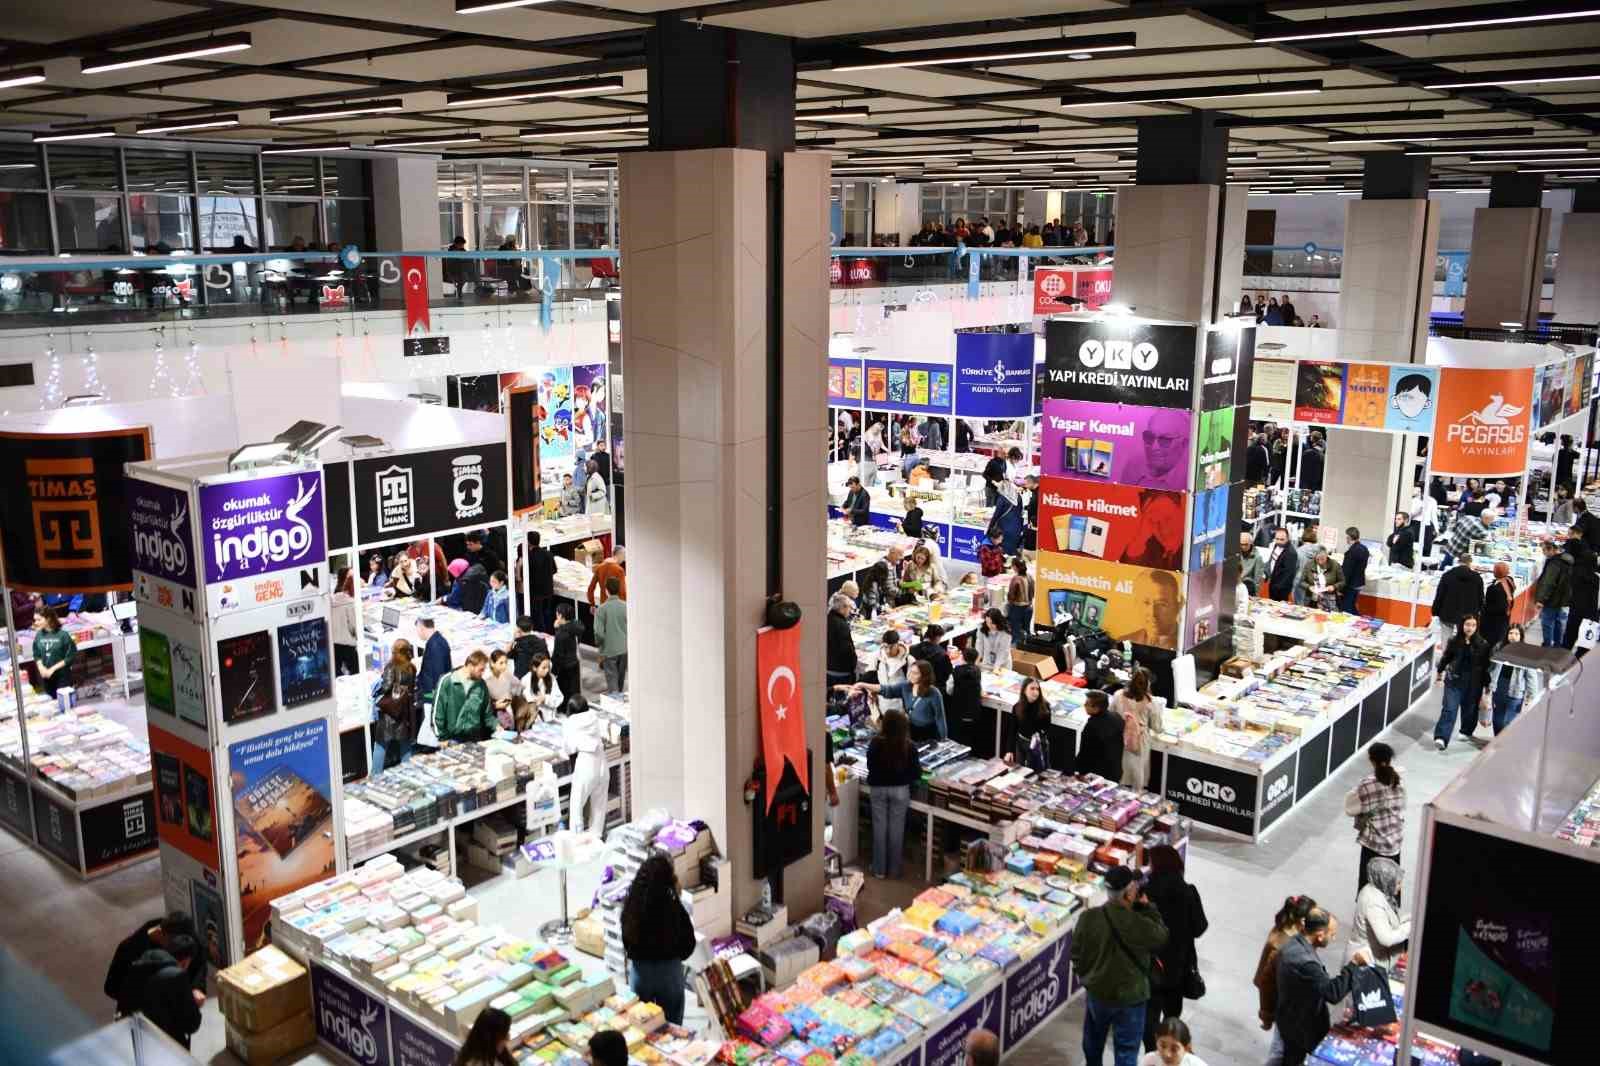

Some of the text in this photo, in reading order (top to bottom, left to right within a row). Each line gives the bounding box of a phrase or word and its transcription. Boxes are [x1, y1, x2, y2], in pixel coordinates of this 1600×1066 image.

[961, 367, 993, 376] TÜRKİYE
[1049, 369, 1076, 383] YAPI
[1079, 371, 1118, 386] KREDİ
[1120, 374, 1189, 391] YAYINLARI
[1049, 416, 1135, 437] Yaşar Kemal
[1447, 424, 1524, 445] PEGASUS
[1461, 446, 1516, 457] YAYINLARI
[223, 492, 272, 512] okumak
[1042, 492, 1138, 518] Nâzım Hikmet
[212, 508, 283, 530] özgürlüktür
[133, 523, 185, 572] indigo
[213, 524, 310, 566] indigo
[1040, 567, 1134, 594] Sabahattin Ali
[1186, 777, 1237, 803] YKY
[1186, 794, 1211, 808] KREDİ
[1010, 980, 1058, 1035] indigo
[320, 1001, 375, 1057] indigo
